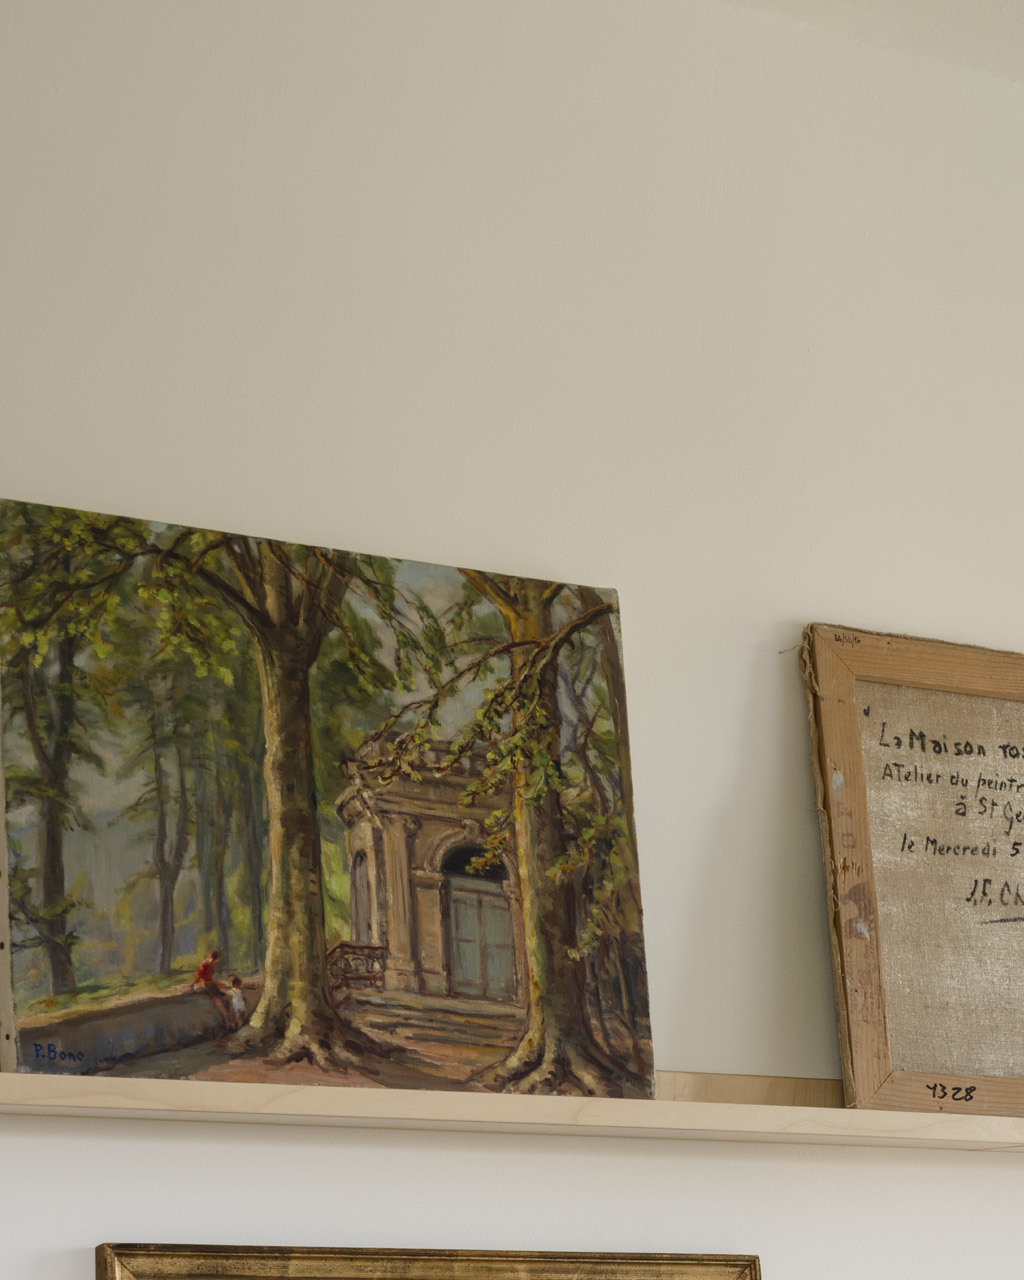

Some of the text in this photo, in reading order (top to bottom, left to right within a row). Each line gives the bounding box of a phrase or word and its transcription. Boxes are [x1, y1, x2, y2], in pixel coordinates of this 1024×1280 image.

[908, 728, 986, 757] Maison
[950, 772, 969, 789] du
[955, 795, 967, 816] à
[978, 797, 999, 818] St
[901, 833, 915, 853] le
[924, 835, 997, 858] Mercredi
[1010, 841, 1022, 858] 5
